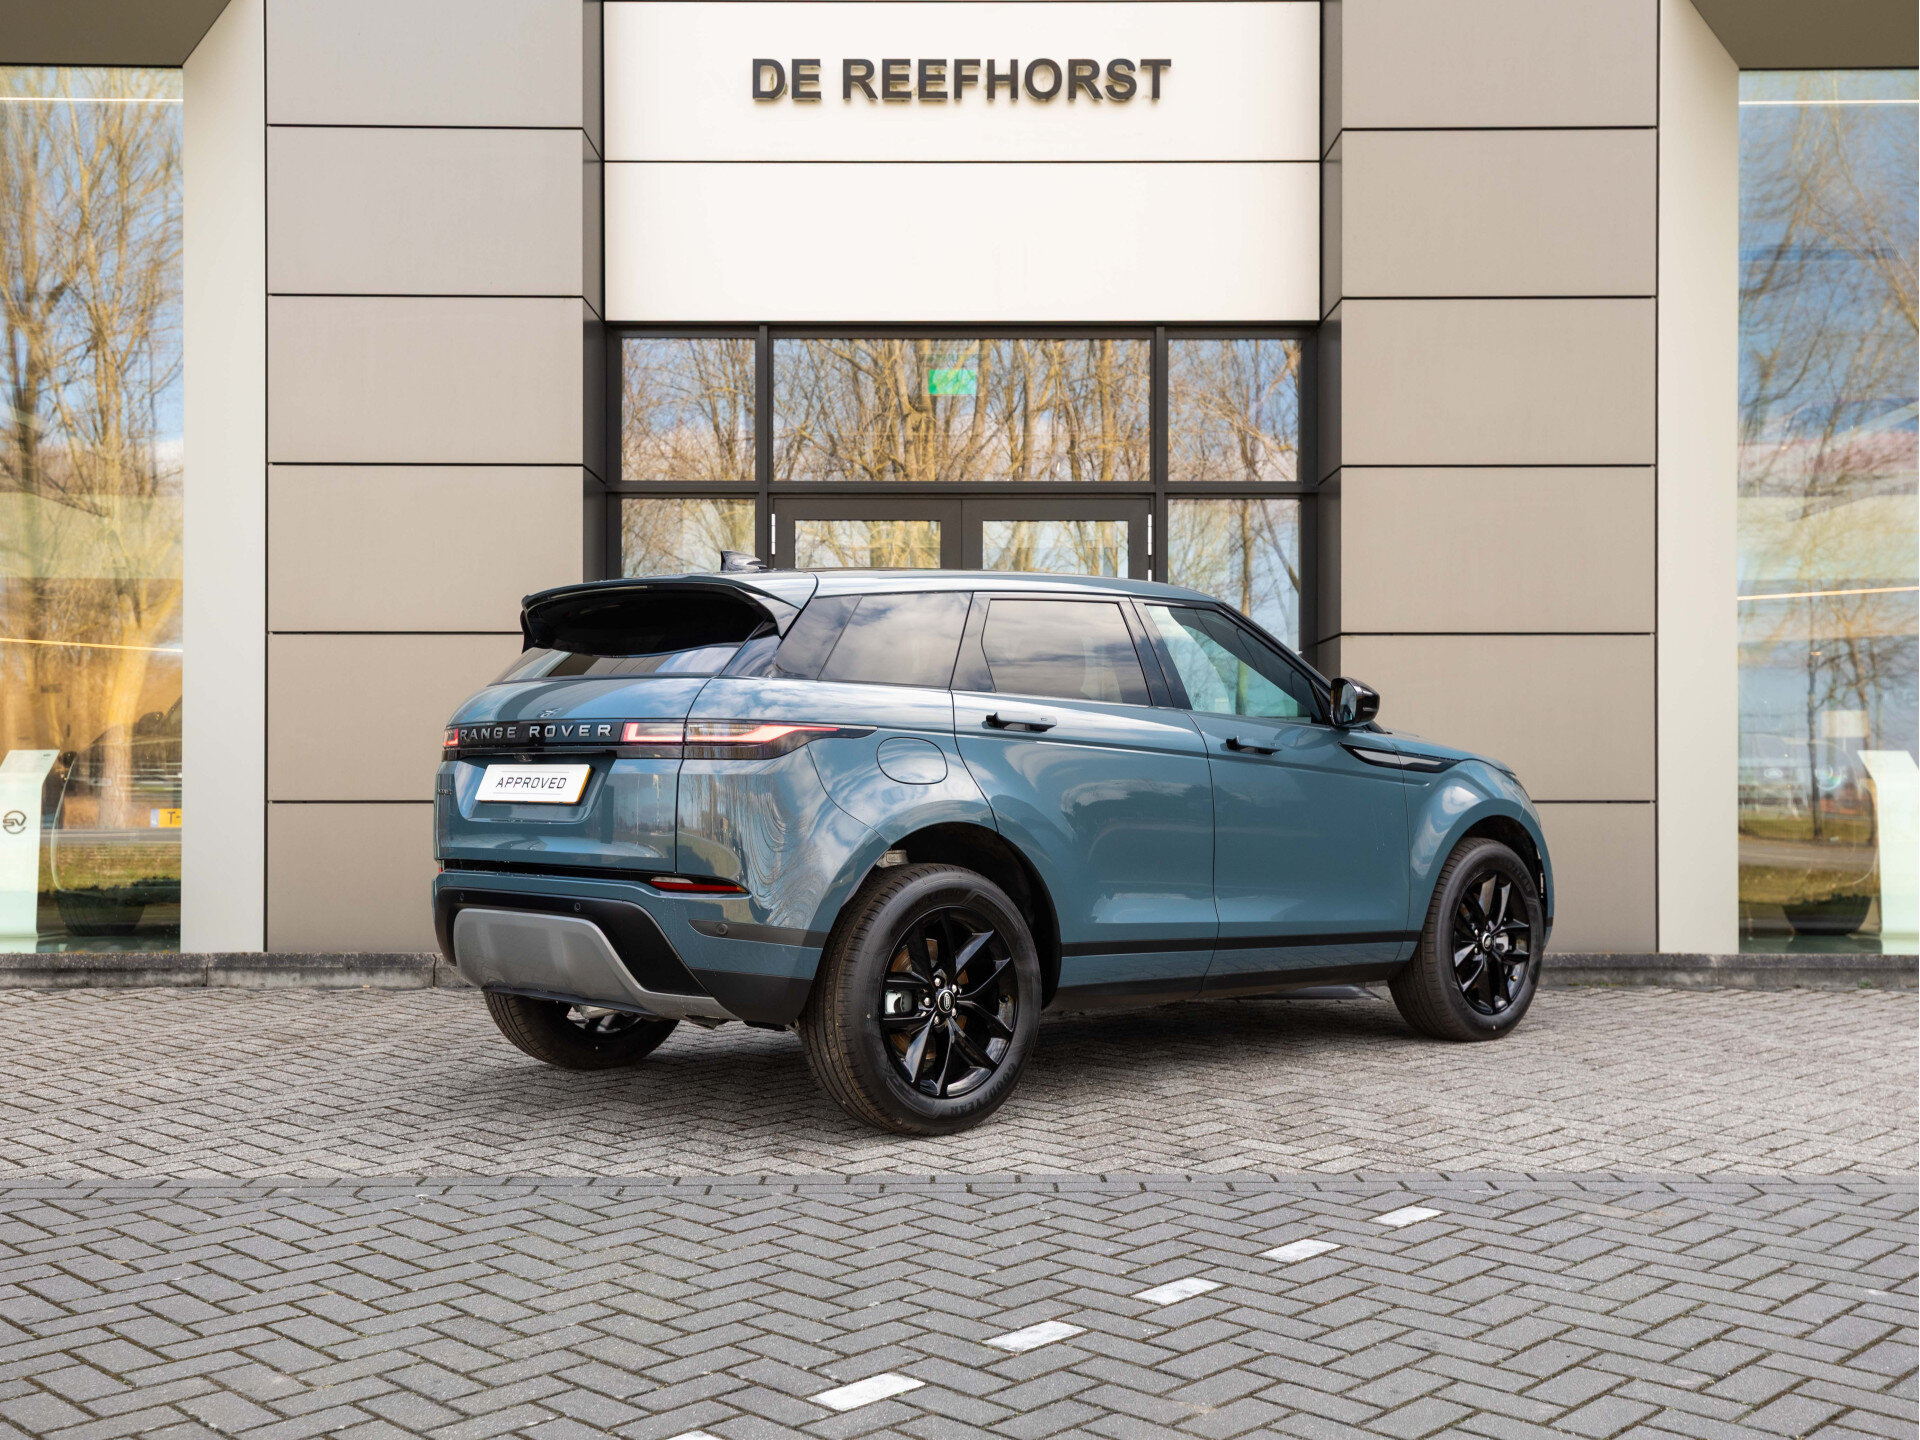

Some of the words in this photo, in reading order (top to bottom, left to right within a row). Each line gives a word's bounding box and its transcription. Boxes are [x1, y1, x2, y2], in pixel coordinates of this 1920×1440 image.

[752, 58, 822, 101] DE
[842, 58, 1172, 101] REEFHORST
[460, 726, 518, 741] RANGE
[529, 724, 613, 738] ROVER
[496, 777, 567, 789] APPROVED
